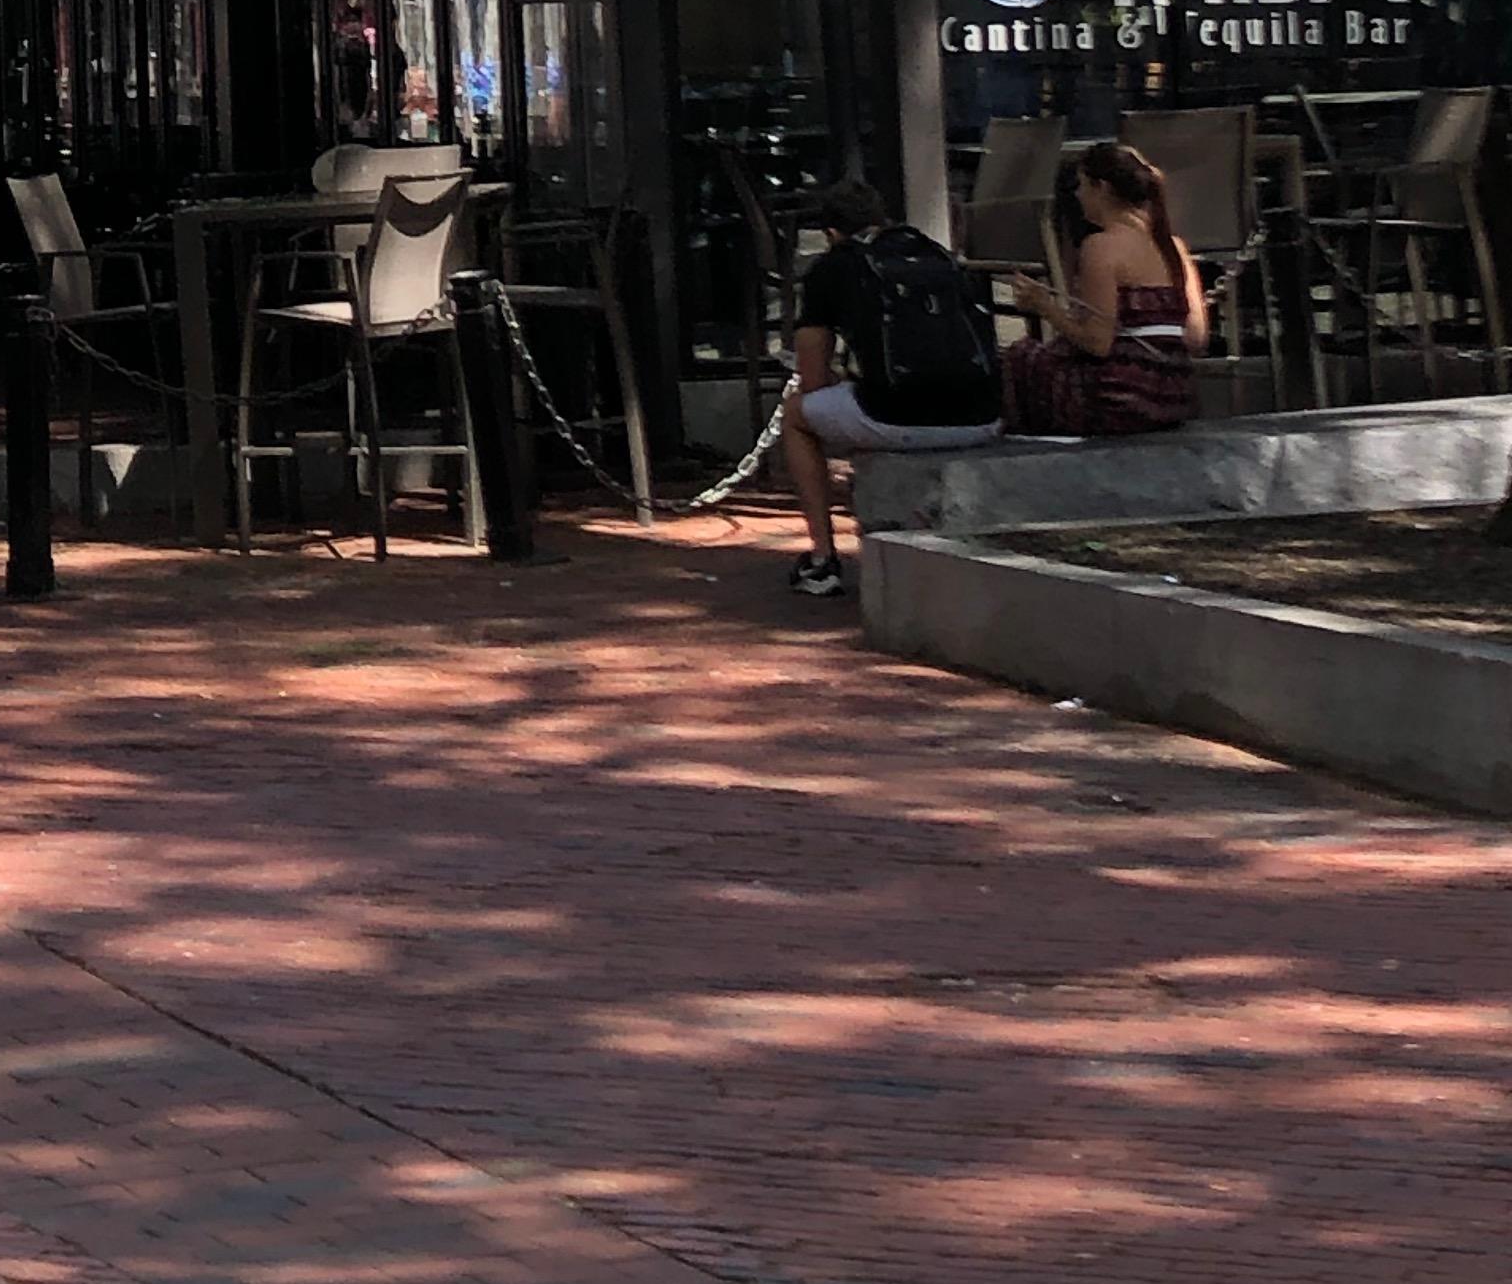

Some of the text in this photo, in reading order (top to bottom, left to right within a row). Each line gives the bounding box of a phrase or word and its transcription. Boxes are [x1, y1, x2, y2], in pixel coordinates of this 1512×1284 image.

[940, 16, 1095, 53] Cantina
[1117, 11, 1145, 49] &
[1345, 10, 1411, 45] Bar
